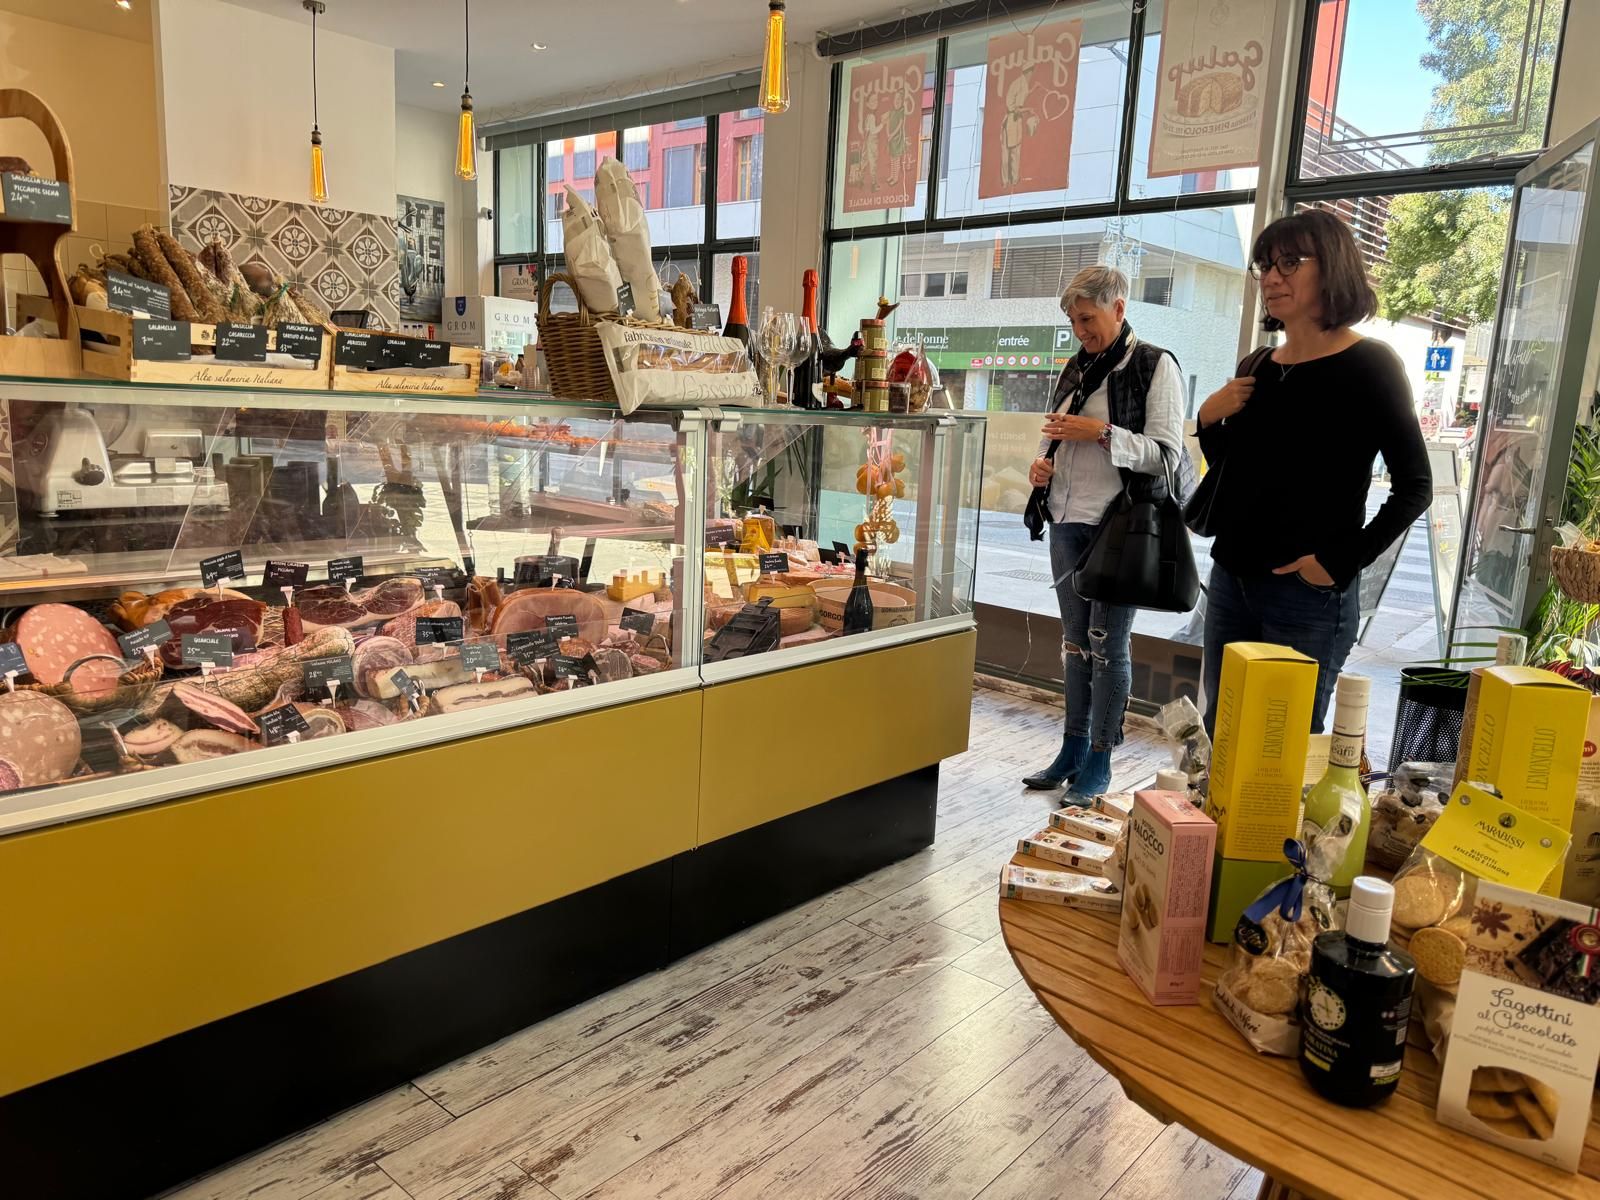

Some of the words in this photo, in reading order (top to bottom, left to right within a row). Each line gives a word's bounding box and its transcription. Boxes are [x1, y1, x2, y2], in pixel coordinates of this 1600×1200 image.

[447, 321, 476, 330] GROM
[494, 312, 530, 325] GROM
[999, 334, 1030, 346] entrée
[1056, 330, 1071, 348] P
[190, 368, 211, 381] Alta
[214, 368, 250, 384] salumeria
[253, 371, 283, 385] Italiana
[376, 377, 391, 389] Alta
[392, 378, 420, 390] salumeria
[420, 380, 444, 391] Italiana
[1214, 687, 1234, 789] LEMONCELLO
[1262, 698, 1289, 760] LEMONCELLO
[1526, 728, 1557, 791] LEMONCELLO
[1134, 819, 1165, 855] BALOCCO
[1474, 820, 1525, 849] MARABISSI
[1453, 845, 1481, 861] ZENZERO
[1485, 862, 1510, 876] LIMONE
[1470, 849, 1498, 865] BISCOTTI
[1490, 988, 1574, 1026] Fagottini
[1477, 1009, 1491, 1021] al
[1493, 1010, 1577, 1047] Cioccolato
